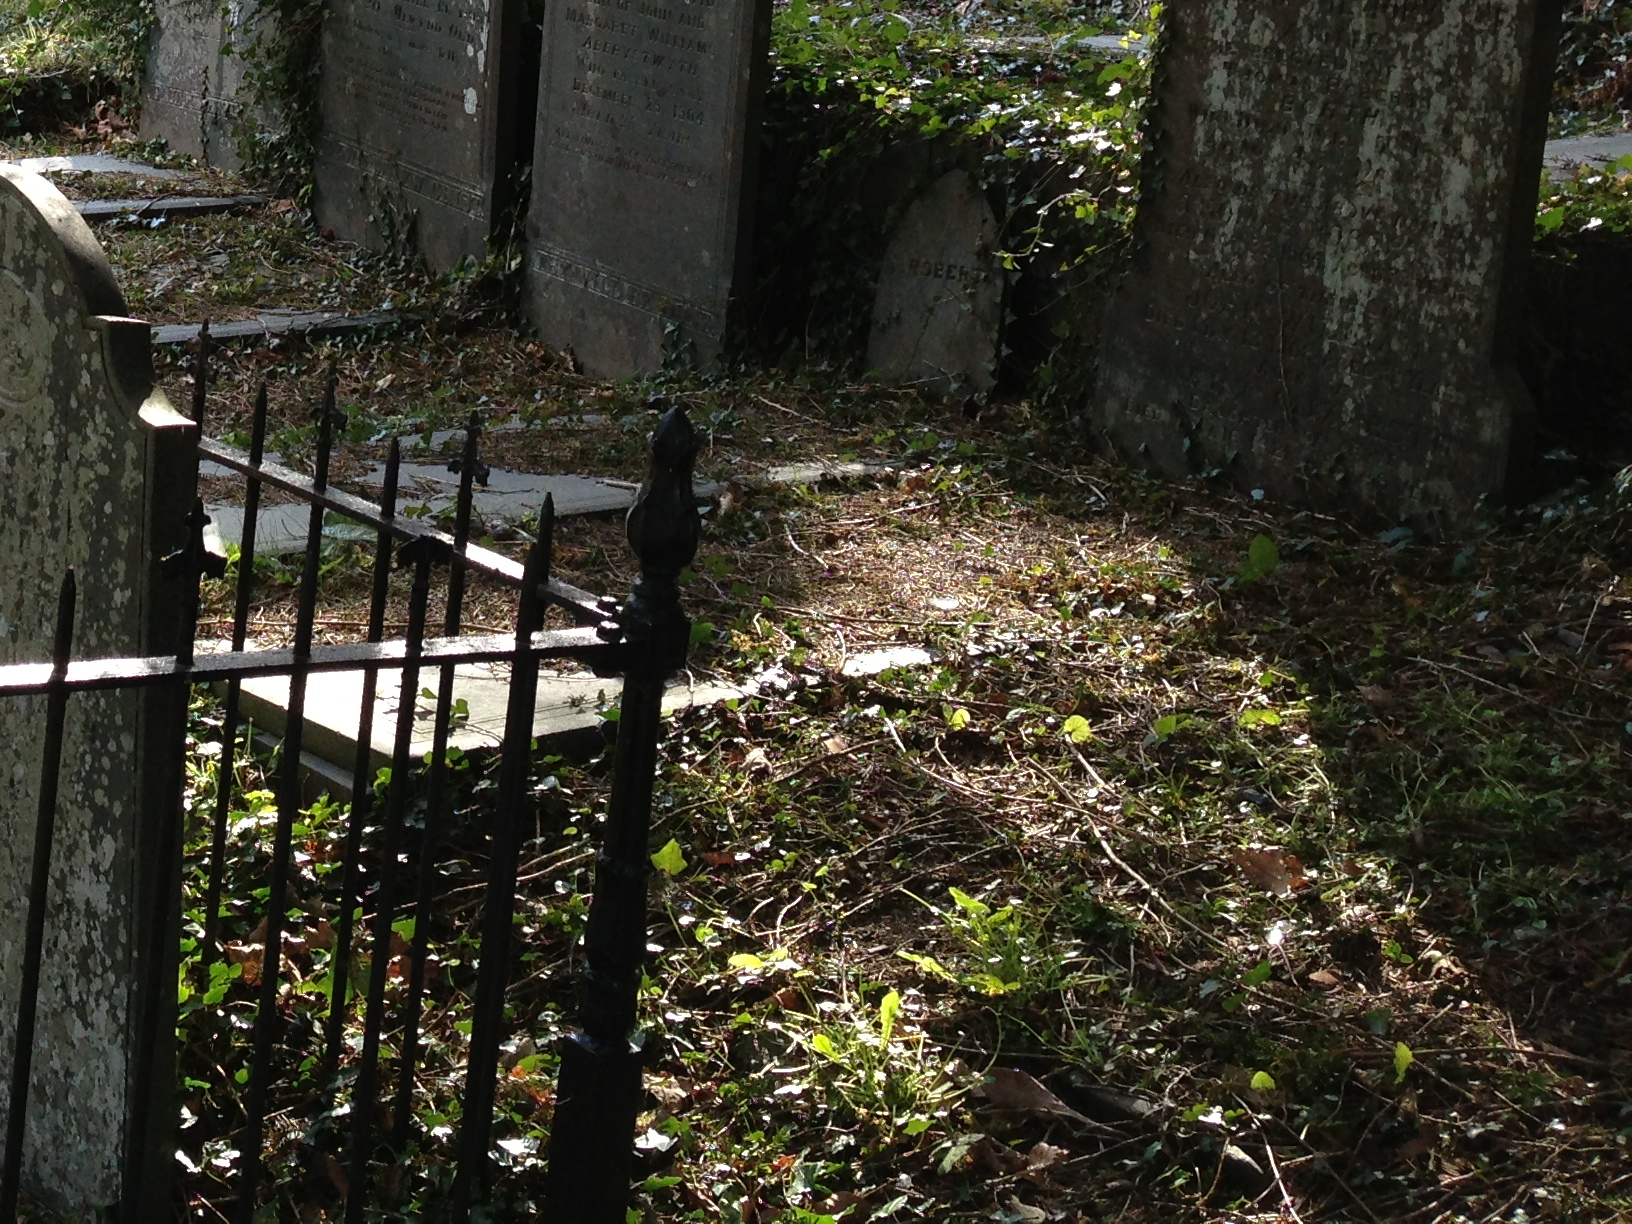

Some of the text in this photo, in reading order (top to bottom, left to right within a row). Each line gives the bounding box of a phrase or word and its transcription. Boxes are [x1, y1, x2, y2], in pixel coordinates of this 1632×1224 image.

[565, 6, 716, 59] MARGARET WILLIAMS
[677, 13, 706, 30] AND
[582, 35, 699, 77] ABERYSTWYTH
[572, 77, 633, 107] DECEMBER
